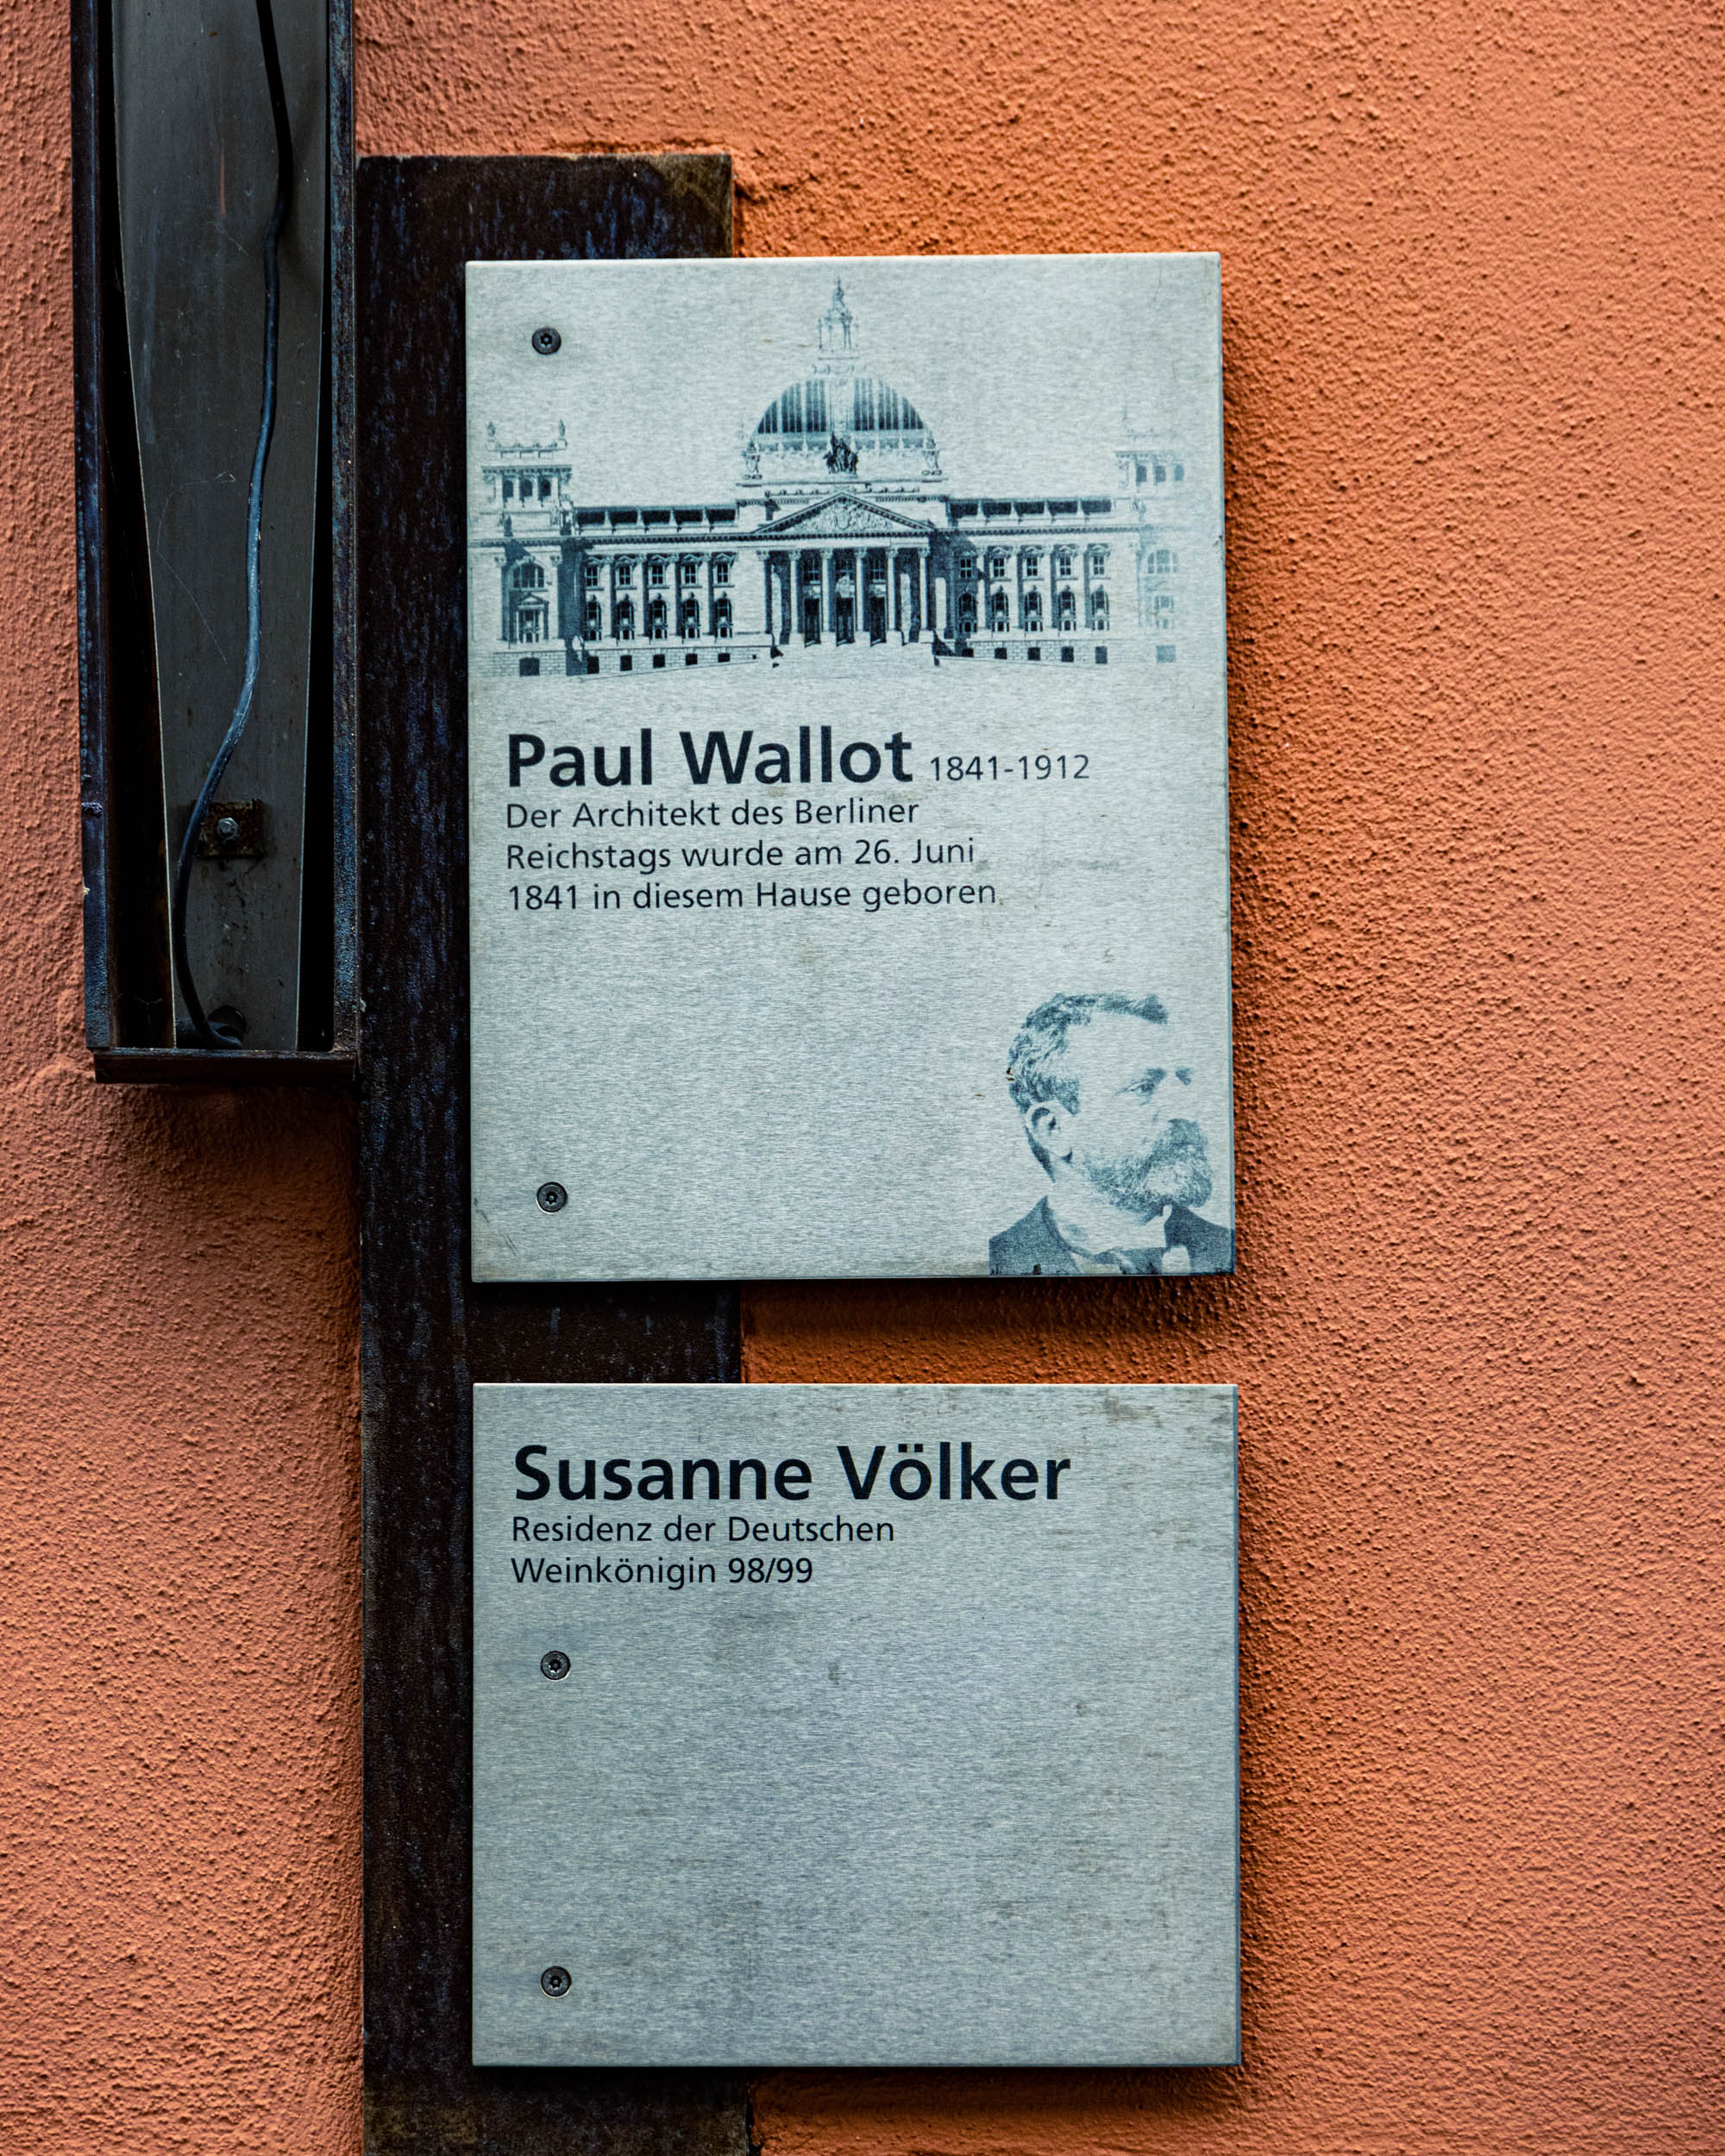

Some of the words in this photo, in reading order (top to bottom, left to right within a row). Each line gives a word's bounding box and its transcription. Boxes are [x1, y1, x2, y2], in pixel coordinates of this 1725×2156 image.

[508, 727, 652, 787] Paul
[680, 725, 913, 785] Wallot
[931, 754, 1089, 781] 1841-1912
[507, 803, 561, 829] Der
[572, 799, 720, 828] Architekt
[731, 799, 784, 825] des
[795, 797, 919, 824] Berliner
[507, 840, 671, 874] Reichstags
[681, 839, 783, 867] wurde
[794, 845, 842, 866] am
[855, 838, 899, 865] 26.
[911, 837, 974, 864] Juni
[509, 885, 578, 910] 1841
[593, 883, 620, 910] in
[632, 881, 743, 909] diesem
[756, 881, 850, 907] Hause
[862, 878, 995, 914] geboren
[514, 1444, 812, 1501] Susanne
[836, 1441, 1071, 1501] Völker
[512, 1514, 652, 1543] Residenz
[663, 1514, 717, 1542] der
[728, 1514, 894, 1542] Deutschen
[510, 1555, 716, 1591] Weinkönigin
[727, 1557, 813, 1584] 98/99
